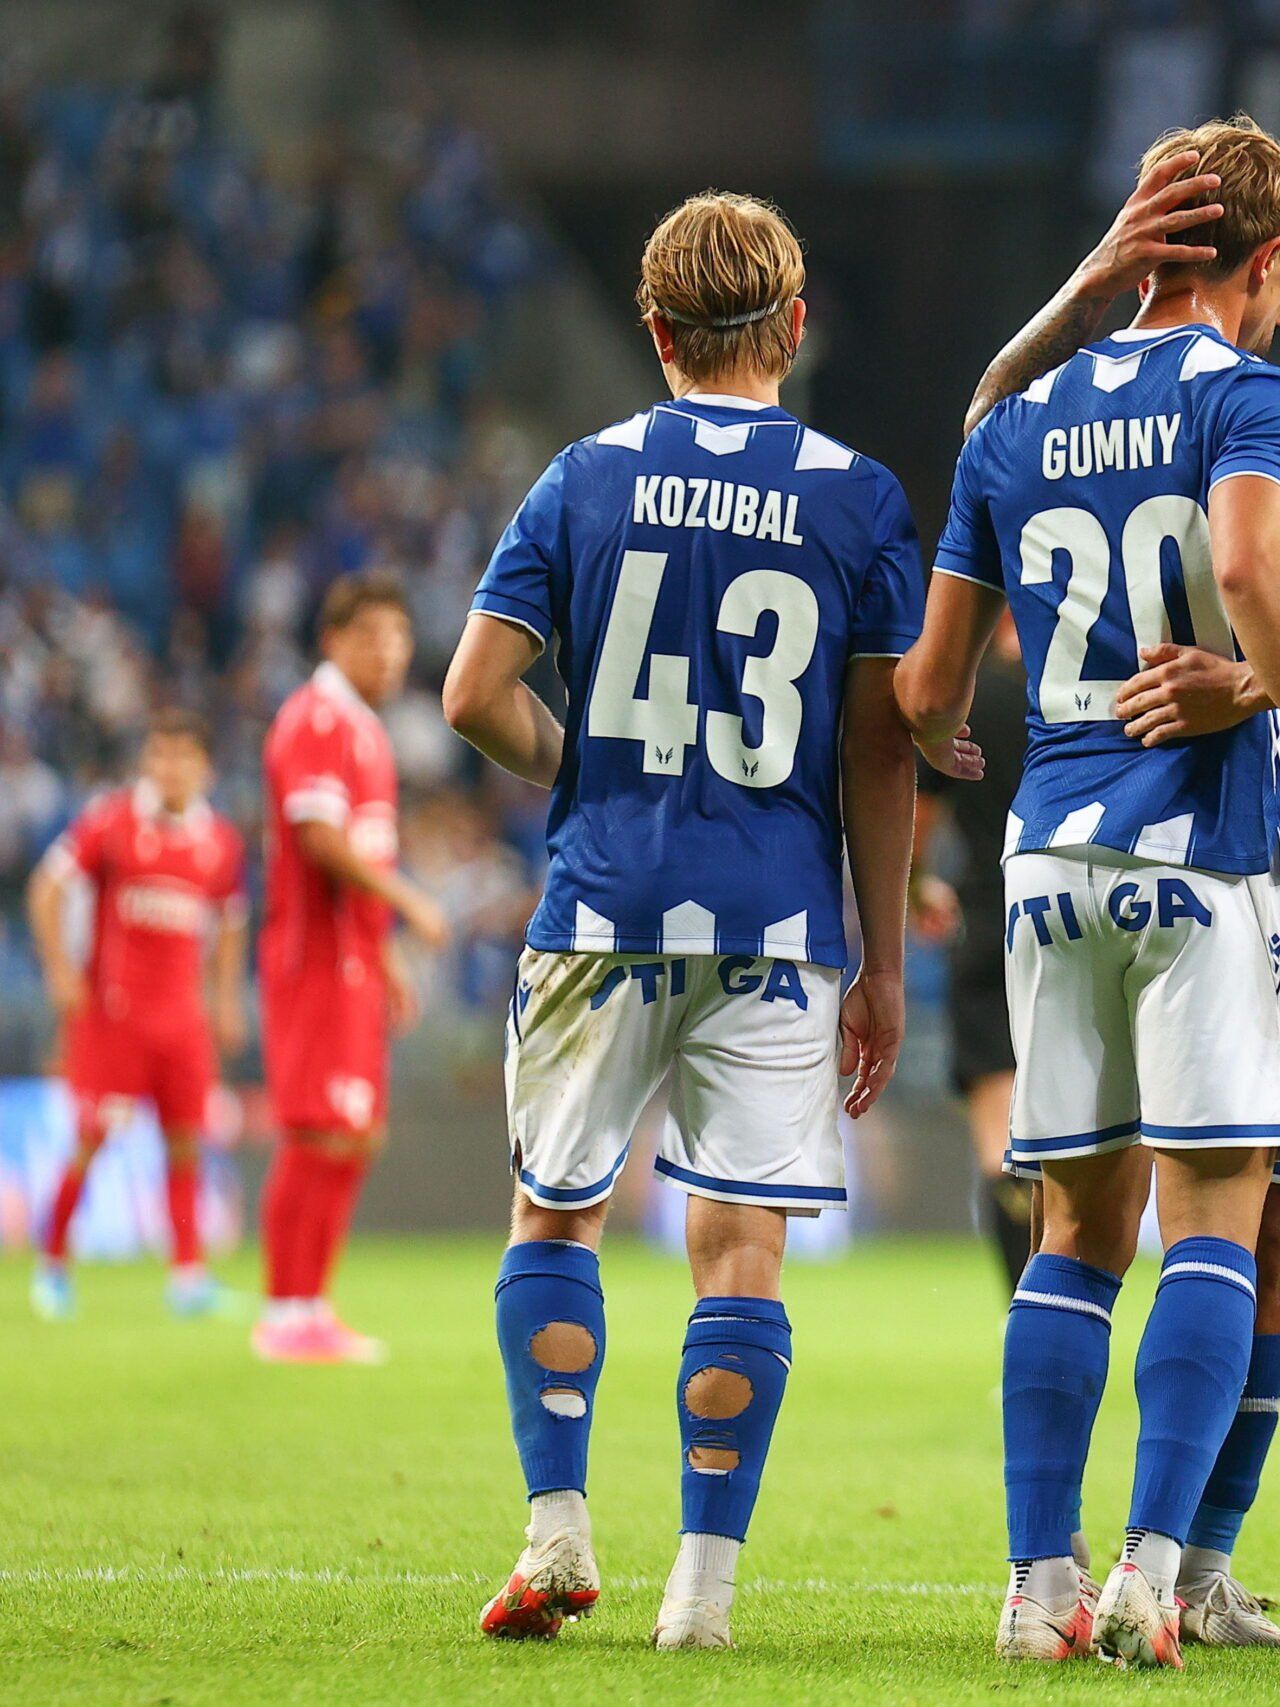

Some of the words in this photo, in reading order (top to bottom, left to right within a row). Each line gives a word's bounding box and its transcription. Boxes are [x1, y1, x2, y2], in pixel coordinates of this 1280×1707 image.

[632, 475, 804, 547] KOZUBAL
[1041, 412, 1182, 481] GUMNY
[587, 549, 820, 788] 43
[1019, 494, 1236, 724] 20
